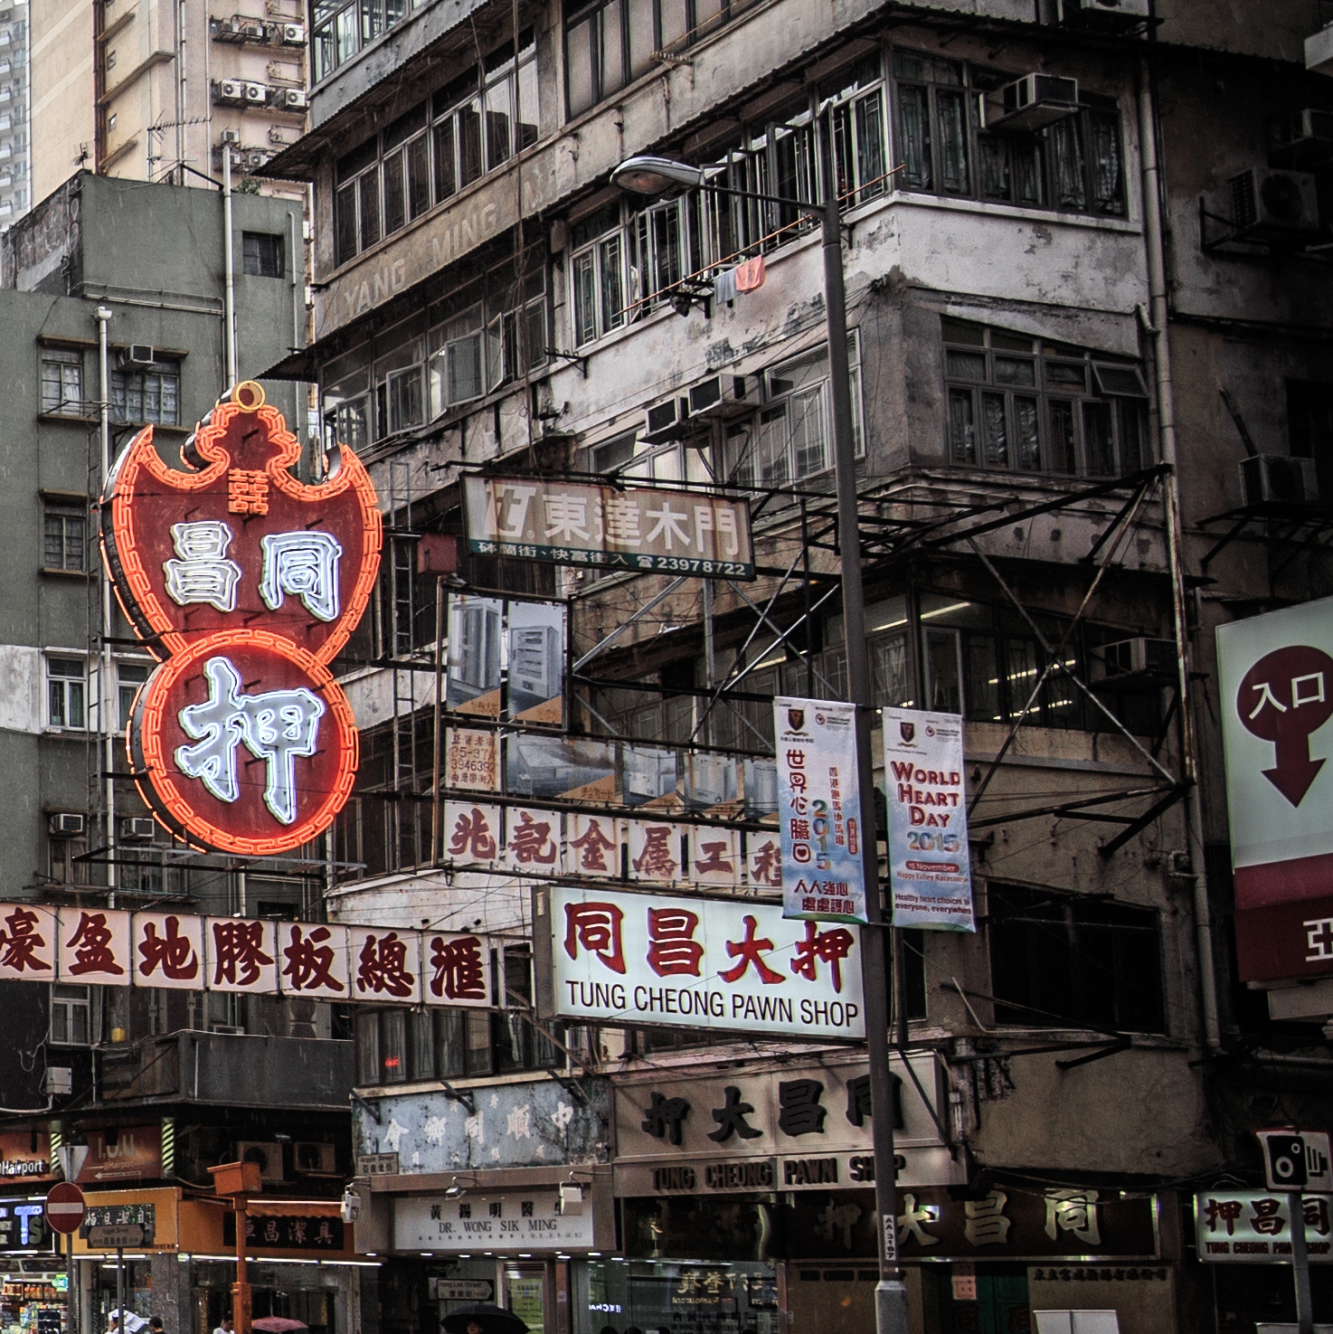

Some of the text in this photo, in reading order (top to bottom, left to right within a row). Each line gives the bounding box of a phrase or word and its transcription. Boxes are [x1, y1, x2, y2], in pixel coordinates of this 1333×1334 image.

[344, 203, 497, 316] YANG MING
[542, 494, 739, 555] 東達木門
[657, 556, 746, 576] 23978722
[1249, 672, 1325, 720] 入口
[174, 655, 325, 826] 押
[890, 761, 961, 786] WORLD
[786, 749, 811, 863] 世界心臟日
[897, 783, 960, 807] HEART
[908, 806, 951, 828] DAY
[811, 799, 831, 871] 2015
[906, 831, 960, 853] 2015
[916, 861, 956, 873] November
[794, 879, 849, 896] 人人強心
[895, 893, 923, 905] Healthy
[564, 901, 854, 994] 同昌大押
[565, 980, 858, 1027] TUNG CHEONG PAWN SHOP
[651, 1154, 906, 1191] TUNG CHEONG PAWN SHP
[439, 1219, 557, 1234] DR. WONG SIK MING
[1206, 1241, 1229, 1254] TUNG
[1233, 1241, 1268, 1254] CHEONG
